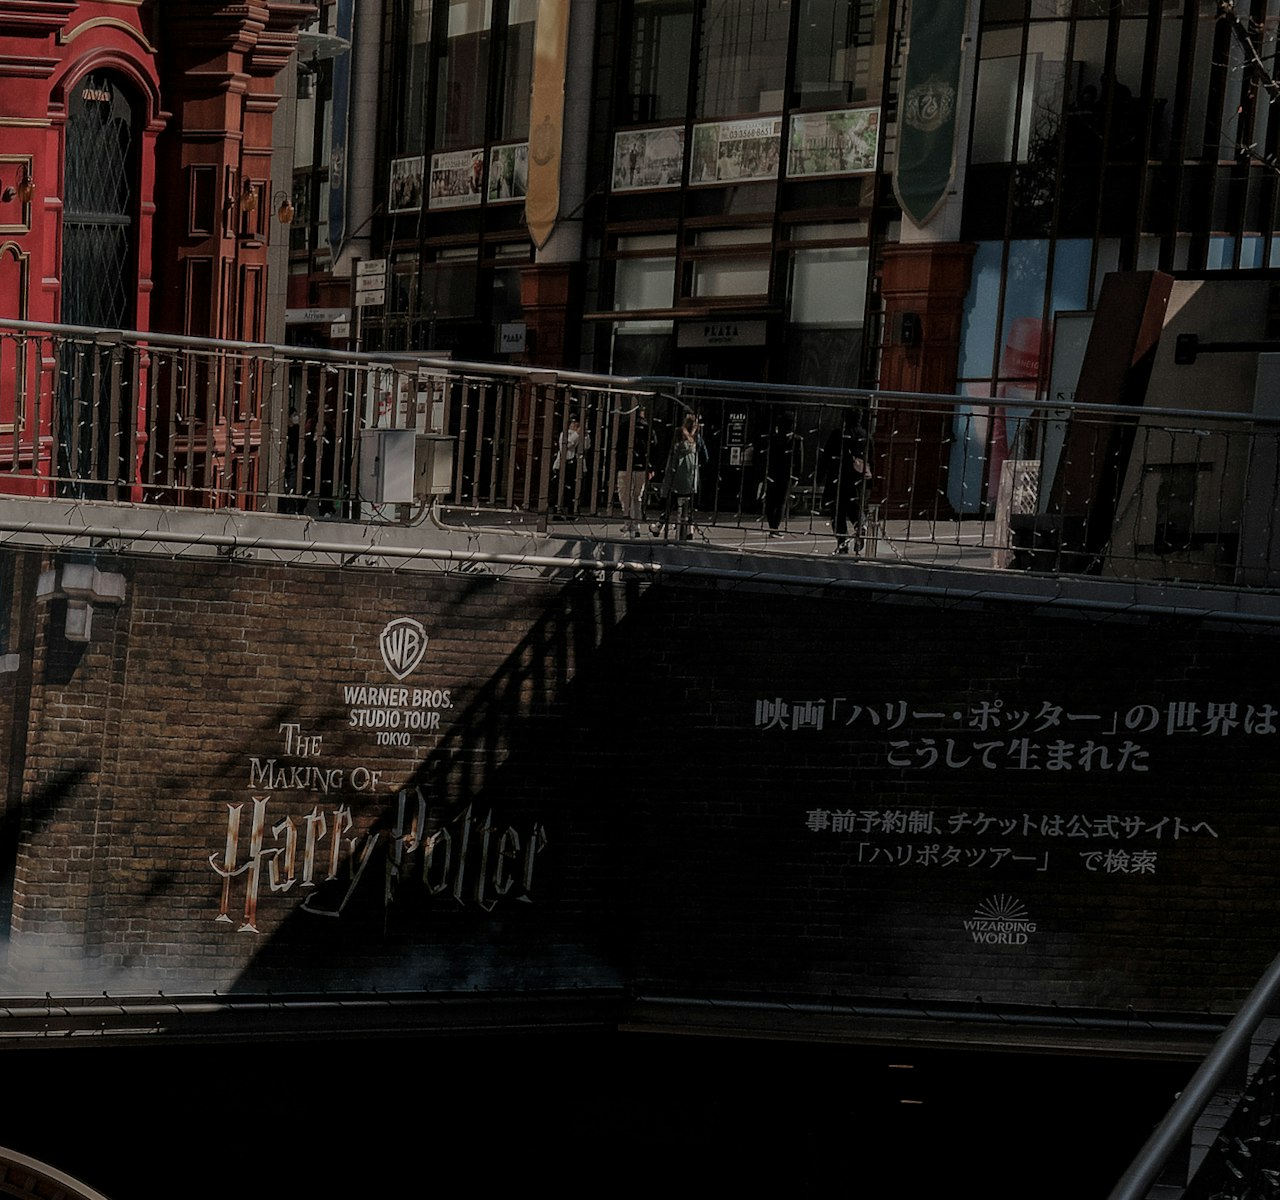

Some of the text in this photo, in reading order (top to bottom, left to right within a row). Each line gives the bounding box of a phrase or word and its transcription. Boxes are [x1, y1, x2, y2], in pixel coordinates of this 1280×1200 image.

[344, 686, 454, 709] WARNER BROS.
[349, 709, 441, 730] STUDIO TOUR
[376, 731, 411, 746] TOKYO
[887, 736, 1151, 773] こうして生まれた
[208, 785, 547, 938] Harry Potter
[1078, 849, 1158, 875] で検索
[963, 920, 1037, 933] WIZARDING
[972, 932, 1029, 945] WORLD
